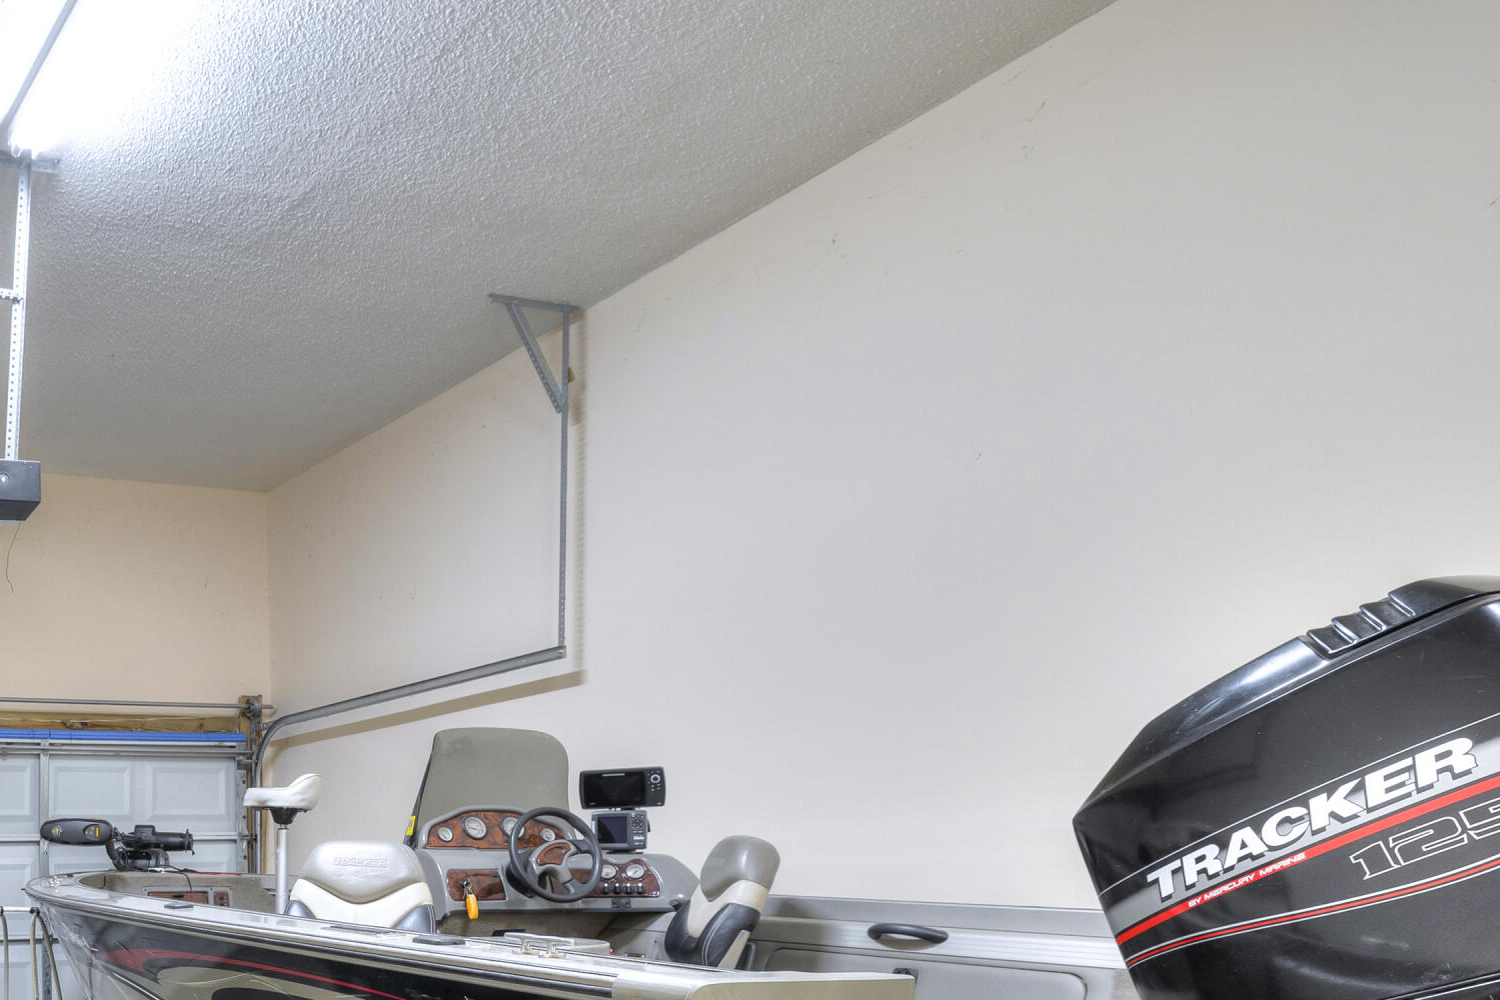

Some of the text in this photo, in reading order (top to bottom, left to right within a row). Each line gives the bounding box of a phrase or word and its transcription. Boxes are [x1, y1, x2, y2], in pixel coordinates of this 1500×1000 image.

[1146, 737, 1479, 902] TRACKER
[1188, 852, 1306, 908] BY MERCURY MARINE
